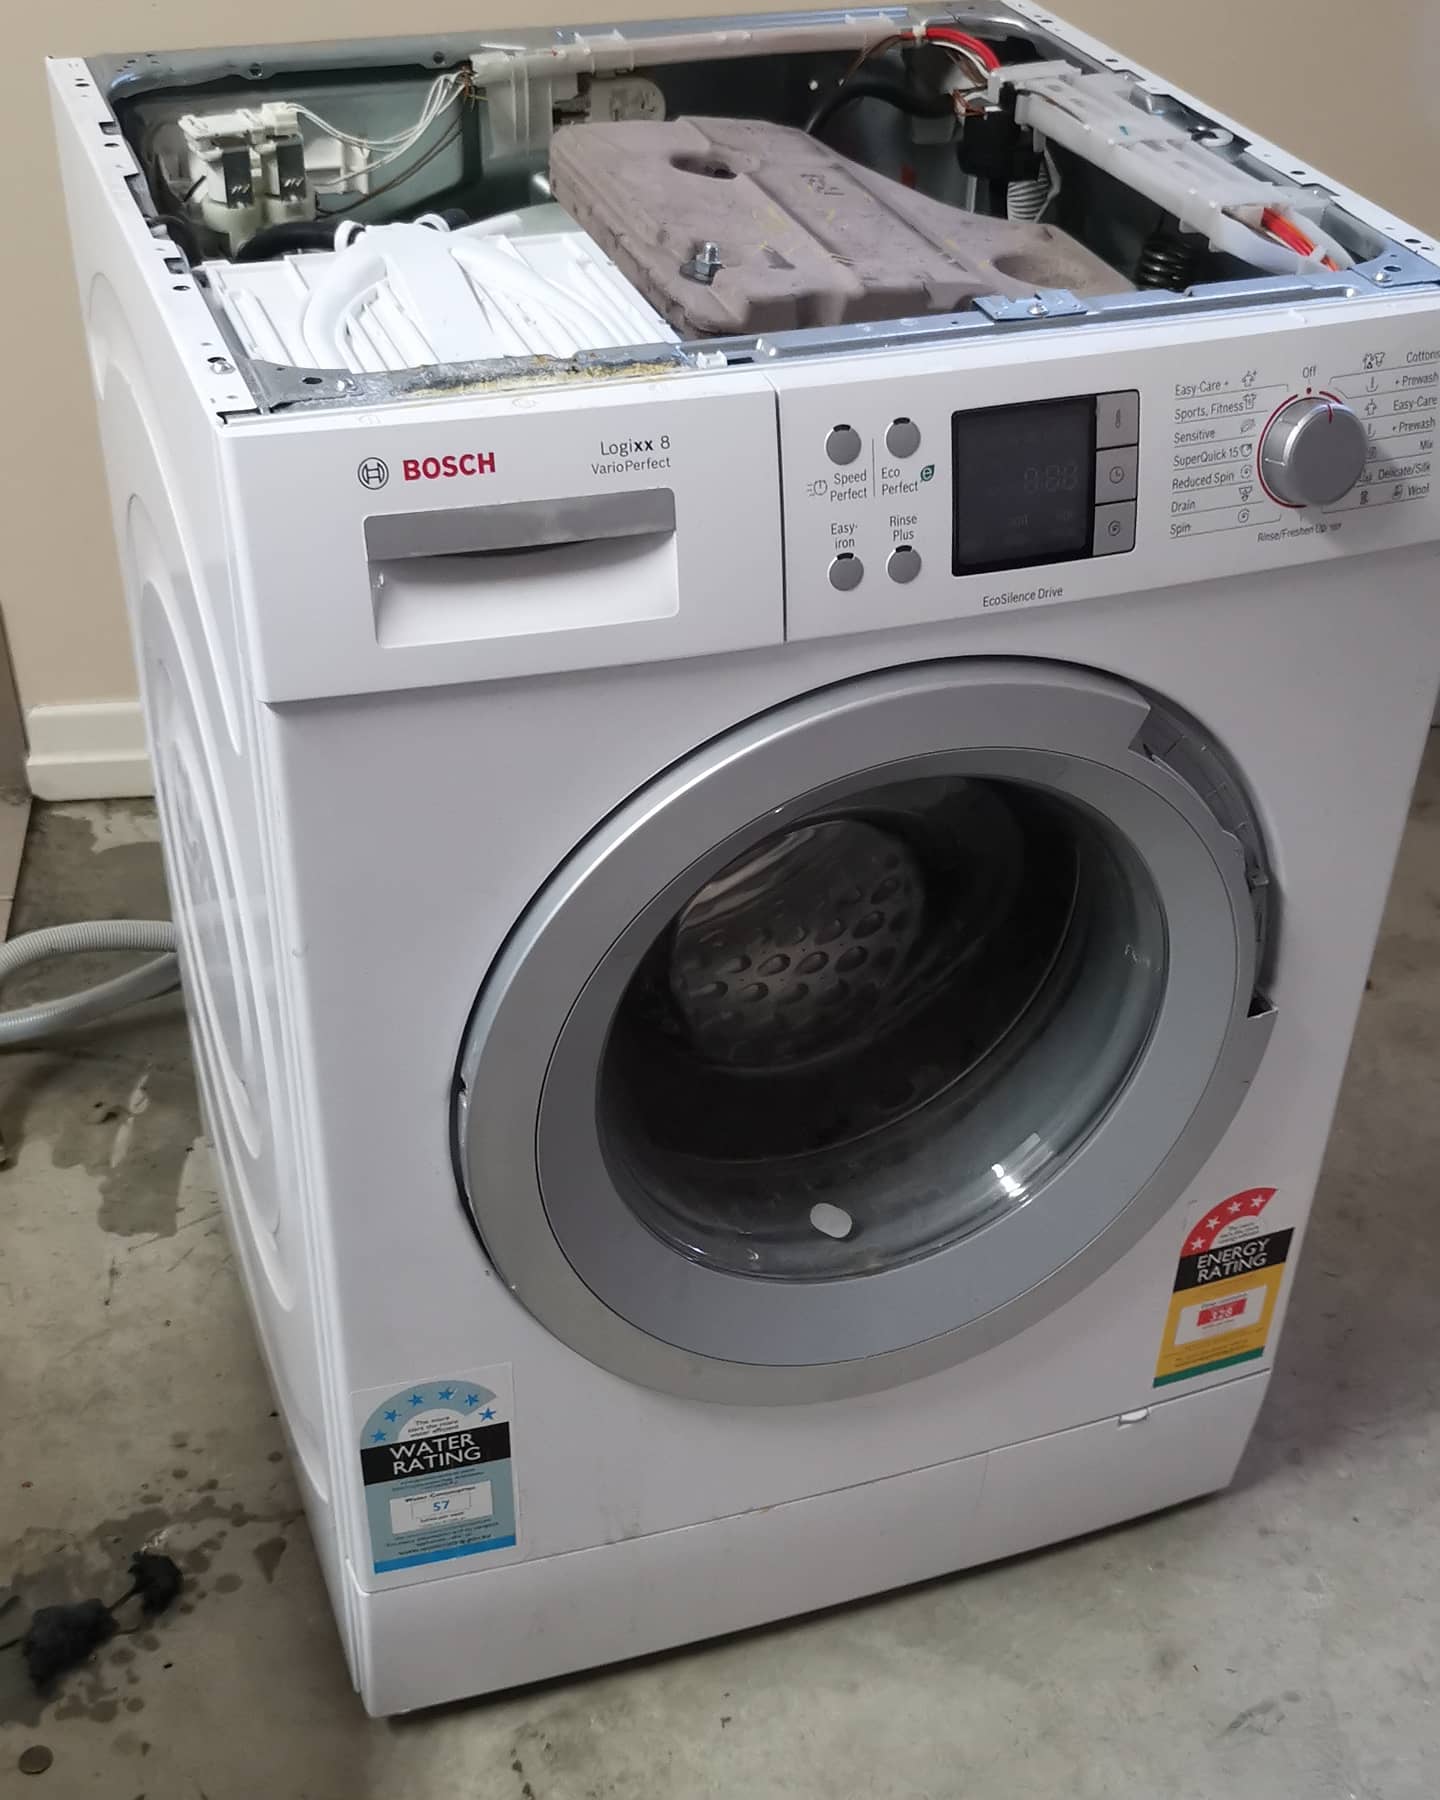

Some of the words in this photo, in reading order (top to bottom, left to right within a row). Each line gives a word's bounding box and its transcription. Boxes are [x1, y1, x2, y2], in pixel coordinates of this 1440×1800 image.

[1302, 366, 1317, 379] Off
[1402, 372, 1439, 386] Prewash
[1174, 407, 1209, 423] Sports,
[1211, 402, 1244, 415] Fitness
[1399, 417, 1436, 432] Prewash
[1174, 430, 1215, 444] Sensitive
[600, 437, 654, 458] Logixx
[660, 435, 671, 450] 8
[1173, 448, 1226, 467] SuperQuick
[1228, 446, 1239, 458] 15
[402, 452, 496, 481] BOSCH
[591, 457, 671, 475] VarioPerfect
[881, 466, 901, 480] Eco
[834, 468, 867, 486] Speed
[1172, 473, 1212, 490] Reduced
[1214, 471, 1234, 486] Spin
[830, 487, 868, 503] Perfect
[881, 481, 919, 496] Perfect
[1408, 483, 1430, 497] Wool
[1171, 499, 1196, 513] Drain
[889, 514, 918, 528] Rinse
[831, 522, 858, 537] Easy-
[892, 529, 915, 542] Plus
[1170, 523, 1191, 537] Spin
[834, 536, 856, 550] iron
[983, 593, 1036, 607] EcoSilence
[1037, 587, 1063, 600] Drive
[1197, 1238, 1271, 1270] ENERGY
[1197, 1252, 1268, 1284] RATING
[390, 1433, 475, 1460] WATER
[393, 1446, 481, 1475] RATING
[433, 1500, 450, 1512] 57
